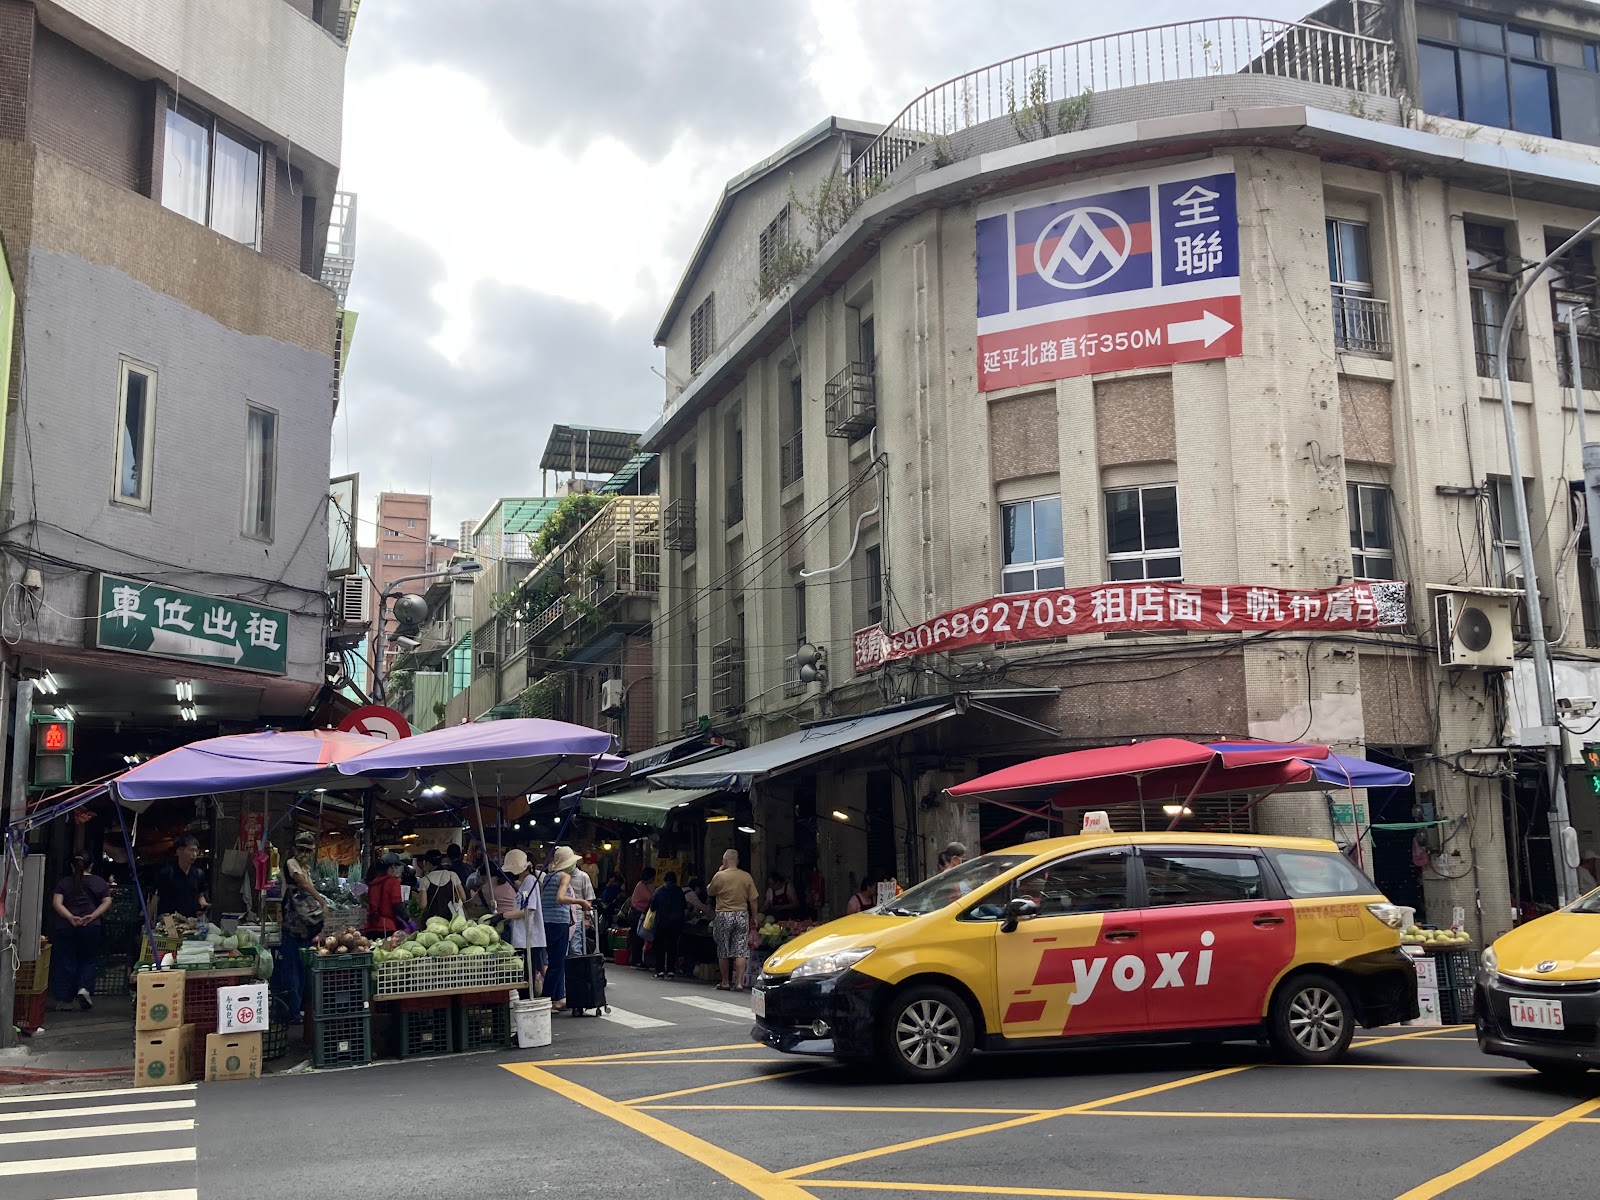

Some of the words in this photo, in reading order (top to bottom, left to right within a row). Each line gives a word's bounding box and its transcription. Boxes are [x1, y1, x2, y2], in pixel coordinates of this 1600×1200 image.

[1173, 184, 1222, 275] 全聯
[983, 327, 1161, 375] 延平北路直行350M
[105, 584, 281, 652] 車位出租
[1091, 586, 1203, 624] 租店面
[1067, 930, 1215, 1006] yoxi
